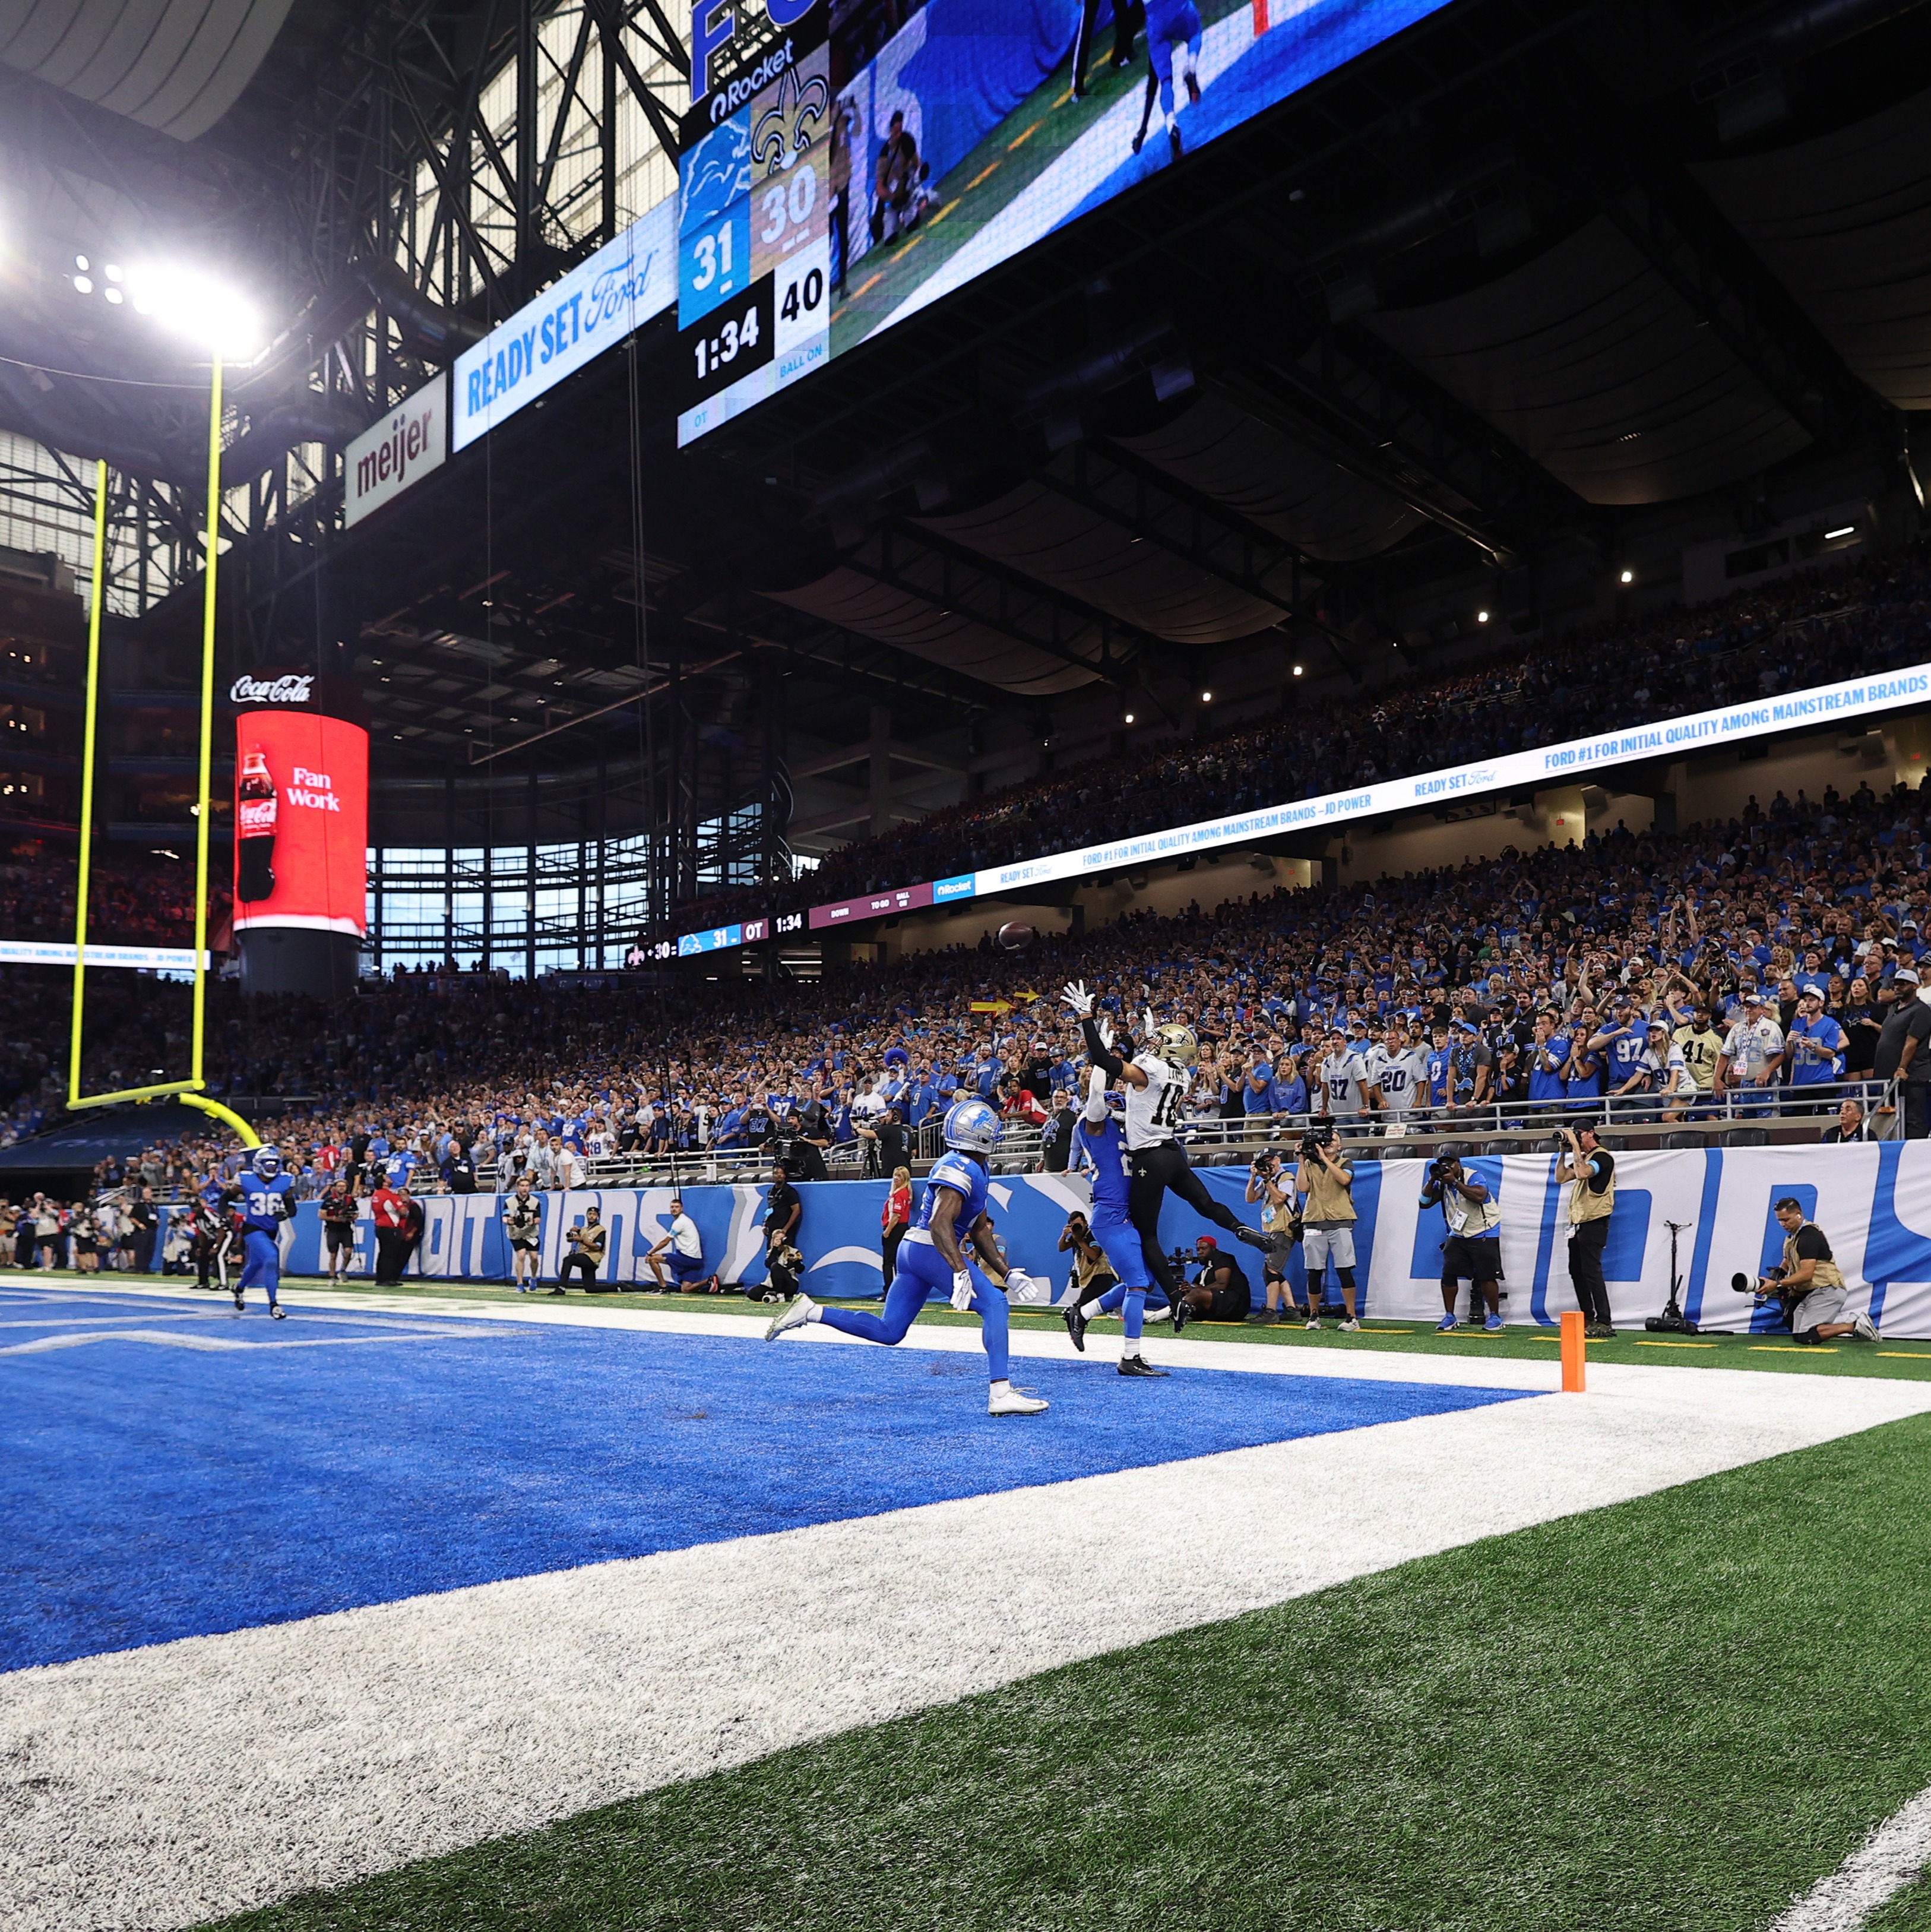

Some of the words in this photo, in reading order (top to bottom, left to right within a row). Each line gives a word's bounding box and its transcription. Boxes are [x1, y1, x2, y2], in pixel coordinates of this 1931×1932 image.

[728, 37, 794, 111] Rocket
[761, 165, 816, 244] 30
[692, 219, 733, 292] 31
[781, 268, 823, 322] 40
[467, 325, 537, 418] READY
[540, 292, 583, 365] SET
[584, 248, 659, 333] Ford
[694, 305, 759, 379] 1:34
[779, 356, 805, 378] BALL
[806, 343, 823, 363] ON
[694, 410, 708, 428] OT
[357, 407, 432, 498] meijer
[230, 674, 315, 703] Coca-Cola
[1545, 750, 1575, 769] FORD
[1578, 746, 1593, 762] #1
[1595, 741, 1619, 758] FOR
[1620, 731, 1663, 753] INITIAL
[1666, 719, 1718, 744] QUALITY
[1721, 709, 1770, 732] AMONG
[1772, 688, 1864, 722] MAINSTREAM
[1868, 675, 1929, 702] BRANDS
[293, 766, 331, 790] Fan
[1414, 778, 1446, 796] READY
[1449, 773, 1467, 790] SET
[1467, 770, 1498, 785] Ford
[286, 787, 341, 812] Work
[1082, 852, 1102, 866] FORD
[1104, 850, 1113, 861] #1
[1114, 847, 1128, 860] FOR
[1130, 841, 1156, 856] INITIAL
[1158, 833, 1190, 850] QUALITY
[1191, 827, 1221, 843] AMONG
[1223, 814, 1278, 836] MAINSTREAM
[1280, 806, 1316, 825] BRANDS
[1337, 794, 1371, 812] POWER
[944, 880, 971, 894] Rocket
[1000, 869, 1020, 884] READY
[1022, 867, 1034, 878] SET
[870, 901, 879, 909] TO
[880, 899, 889, 907] GO
[896, 891, 910, 900] BALL
[776, 913, 802, 932] 1:34
[831, 907, 849, 918] DOWN
[713, 929, 727, 948] 31
[745, 922, 763, 940] OT
[1616, 1037, 1643, 1063] 97
[1682, 1040, 1705, 1064] 41
[1381, 1070, 1407, 1093] 20
[1431, 1061, 1442, 1082] 0
[912, 1092, 921, 1106] 9
[1330, 1079, 1348, 1101] 97
[774, 1102, 790, 1116] 97
[749, 1117, 769, 1133] 87
[249, 1192, 284, 1216] 36
